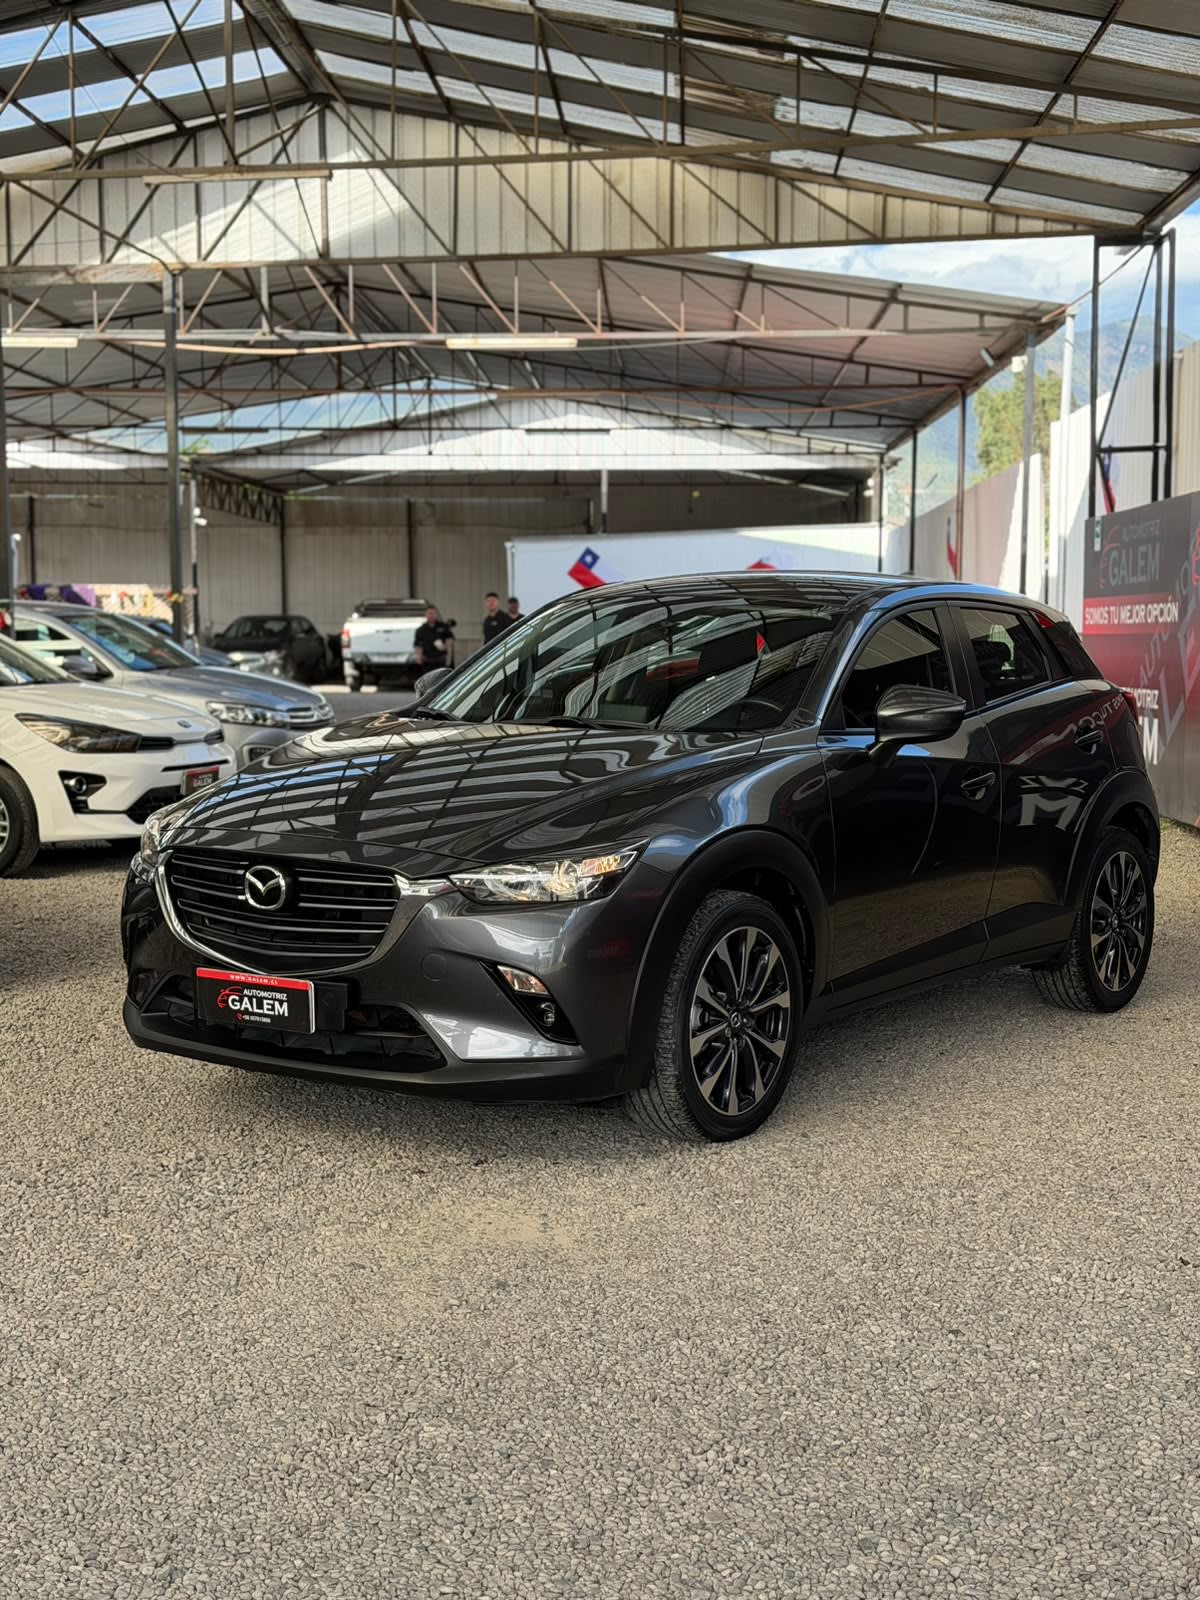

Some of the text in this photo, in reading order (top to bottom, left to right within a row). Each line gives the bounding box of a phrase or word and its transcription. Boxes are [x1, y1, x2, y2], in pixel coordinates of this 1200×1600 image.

[1109, 543, 1160, 586] GALEM
[1085, 595, 1179, 625] SOMOS TU MEJOR OPCIÓN
[228, 994, 289, 1017] GALEM
[243, 988, 288, 1001] AUTOMOTRIZ
